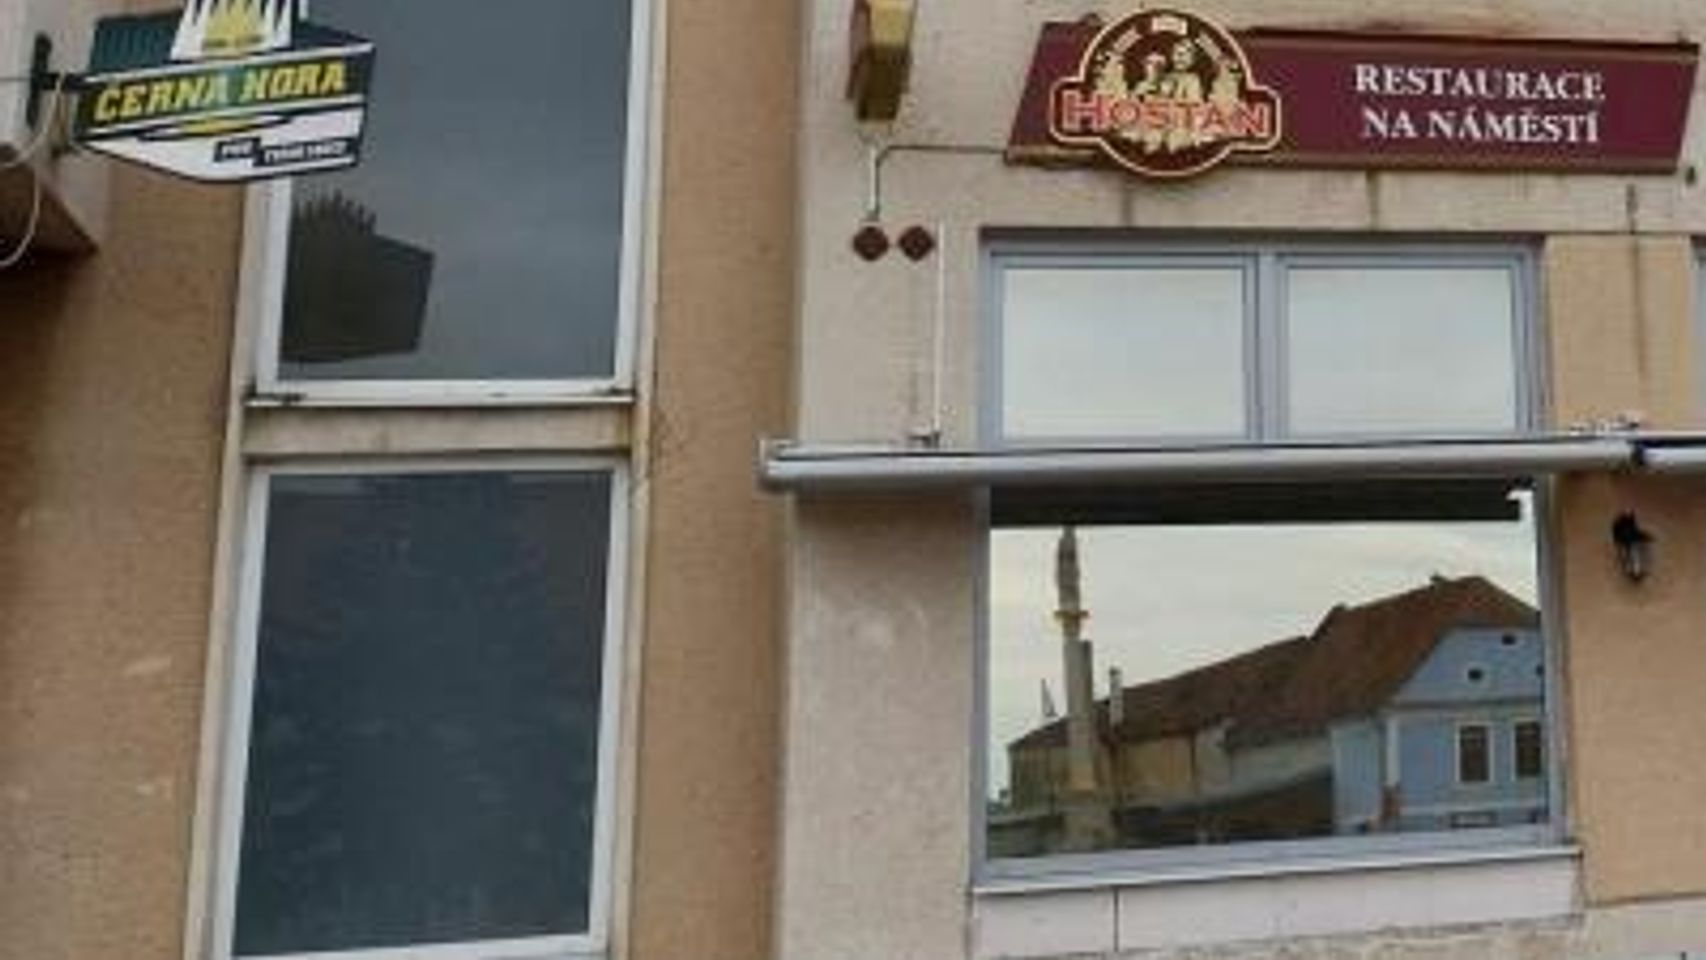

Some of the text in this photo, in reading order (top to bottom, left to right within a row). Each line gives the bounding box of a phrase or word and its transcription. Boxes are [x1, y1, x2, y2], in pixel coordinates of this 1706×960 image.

[1355, 63, 1606, 101] RESTAURACE
[1362, 104, 1600, 143] NA NÁMĚSTÍ
